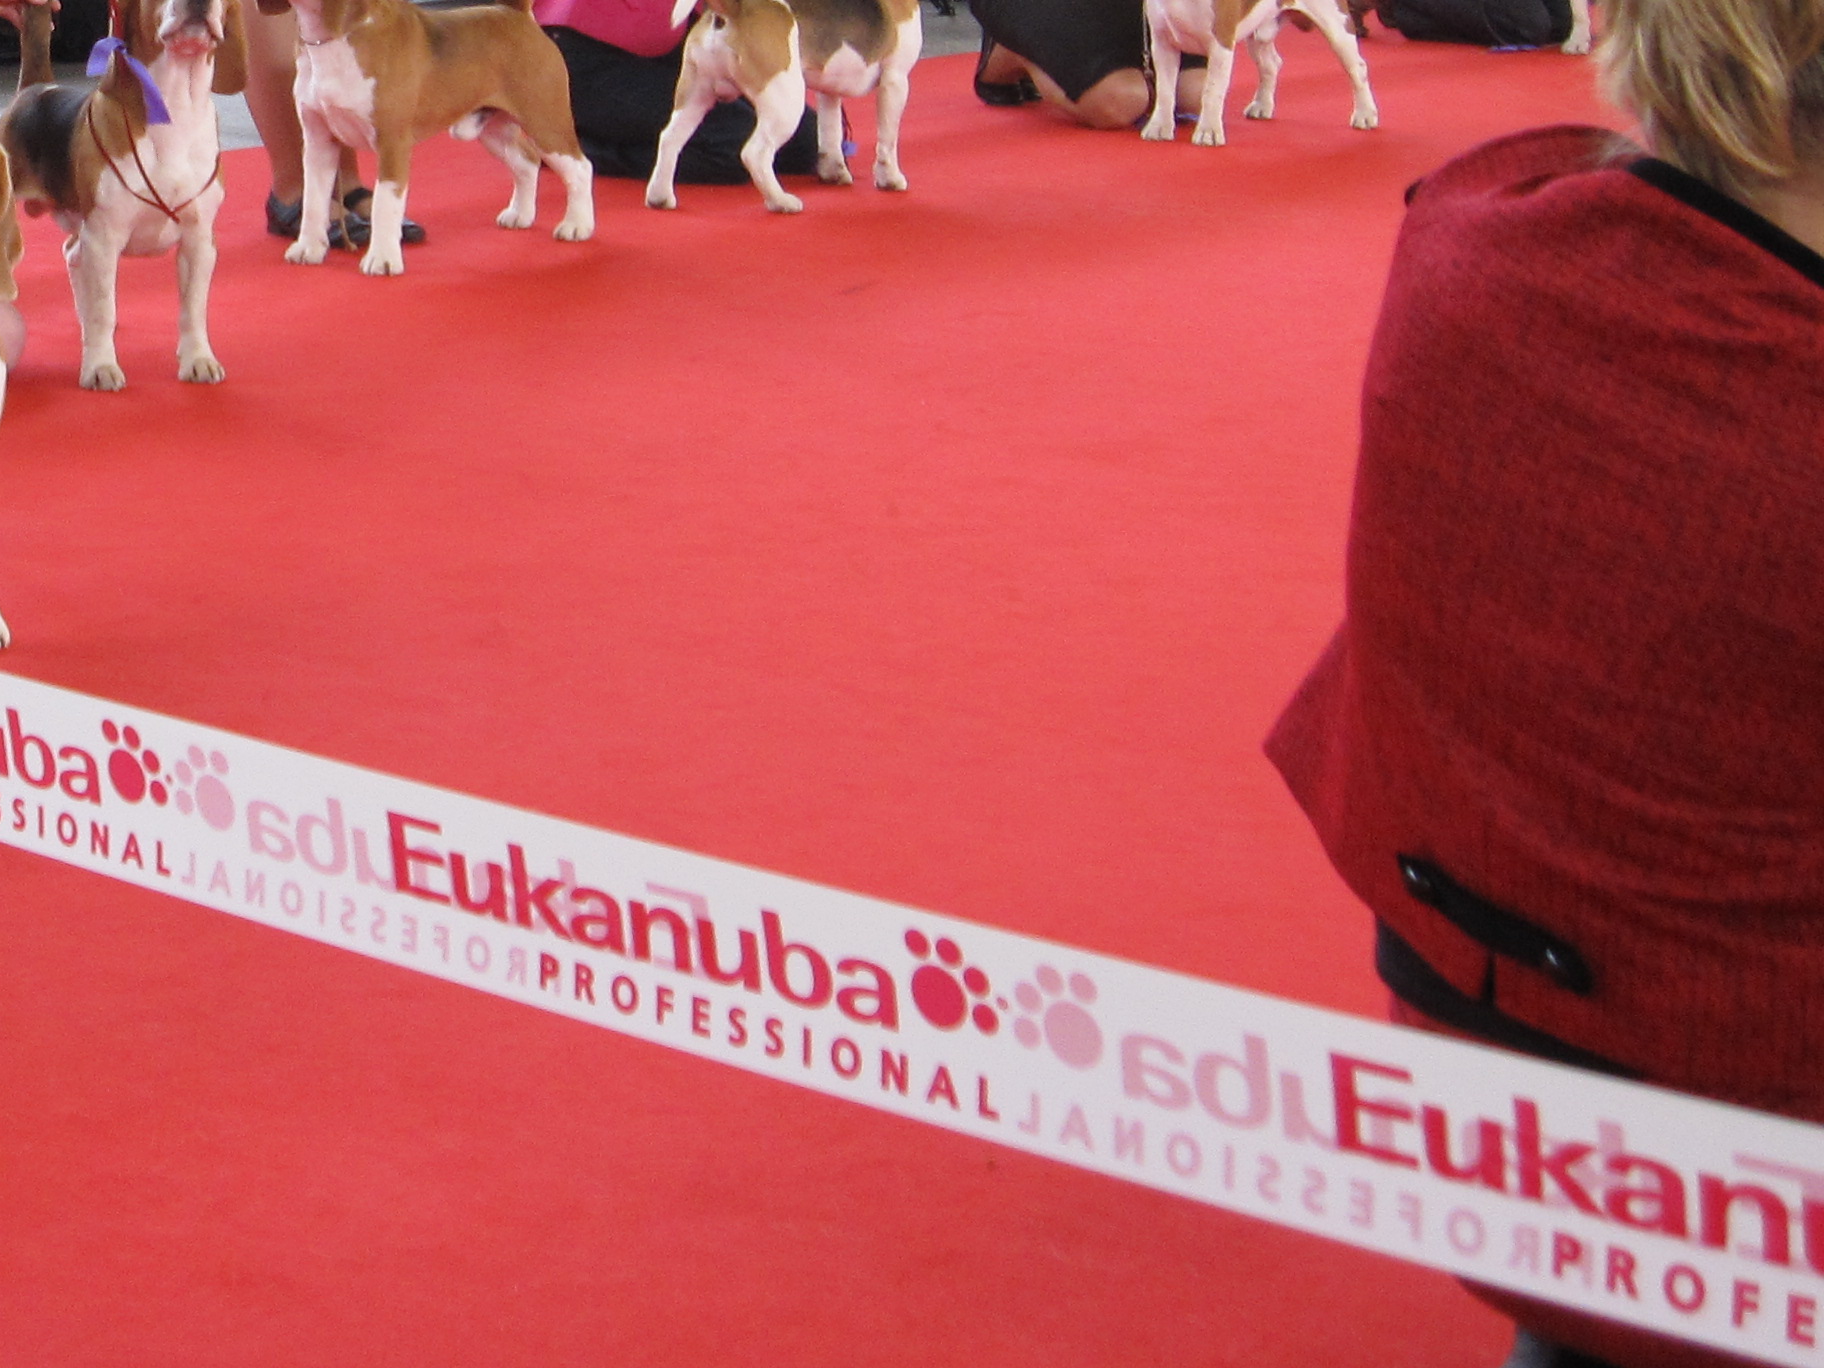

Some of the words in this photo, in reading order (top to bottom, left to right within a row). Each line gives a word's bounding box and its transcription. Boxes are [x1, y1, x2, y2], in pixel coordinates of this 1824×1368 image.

[385, 810, 901, 1030] Eukanuba
[537, 951, 1001, 1123] PROFESSIONAL
[1327, 1050, 1824, 1280] Eukan
